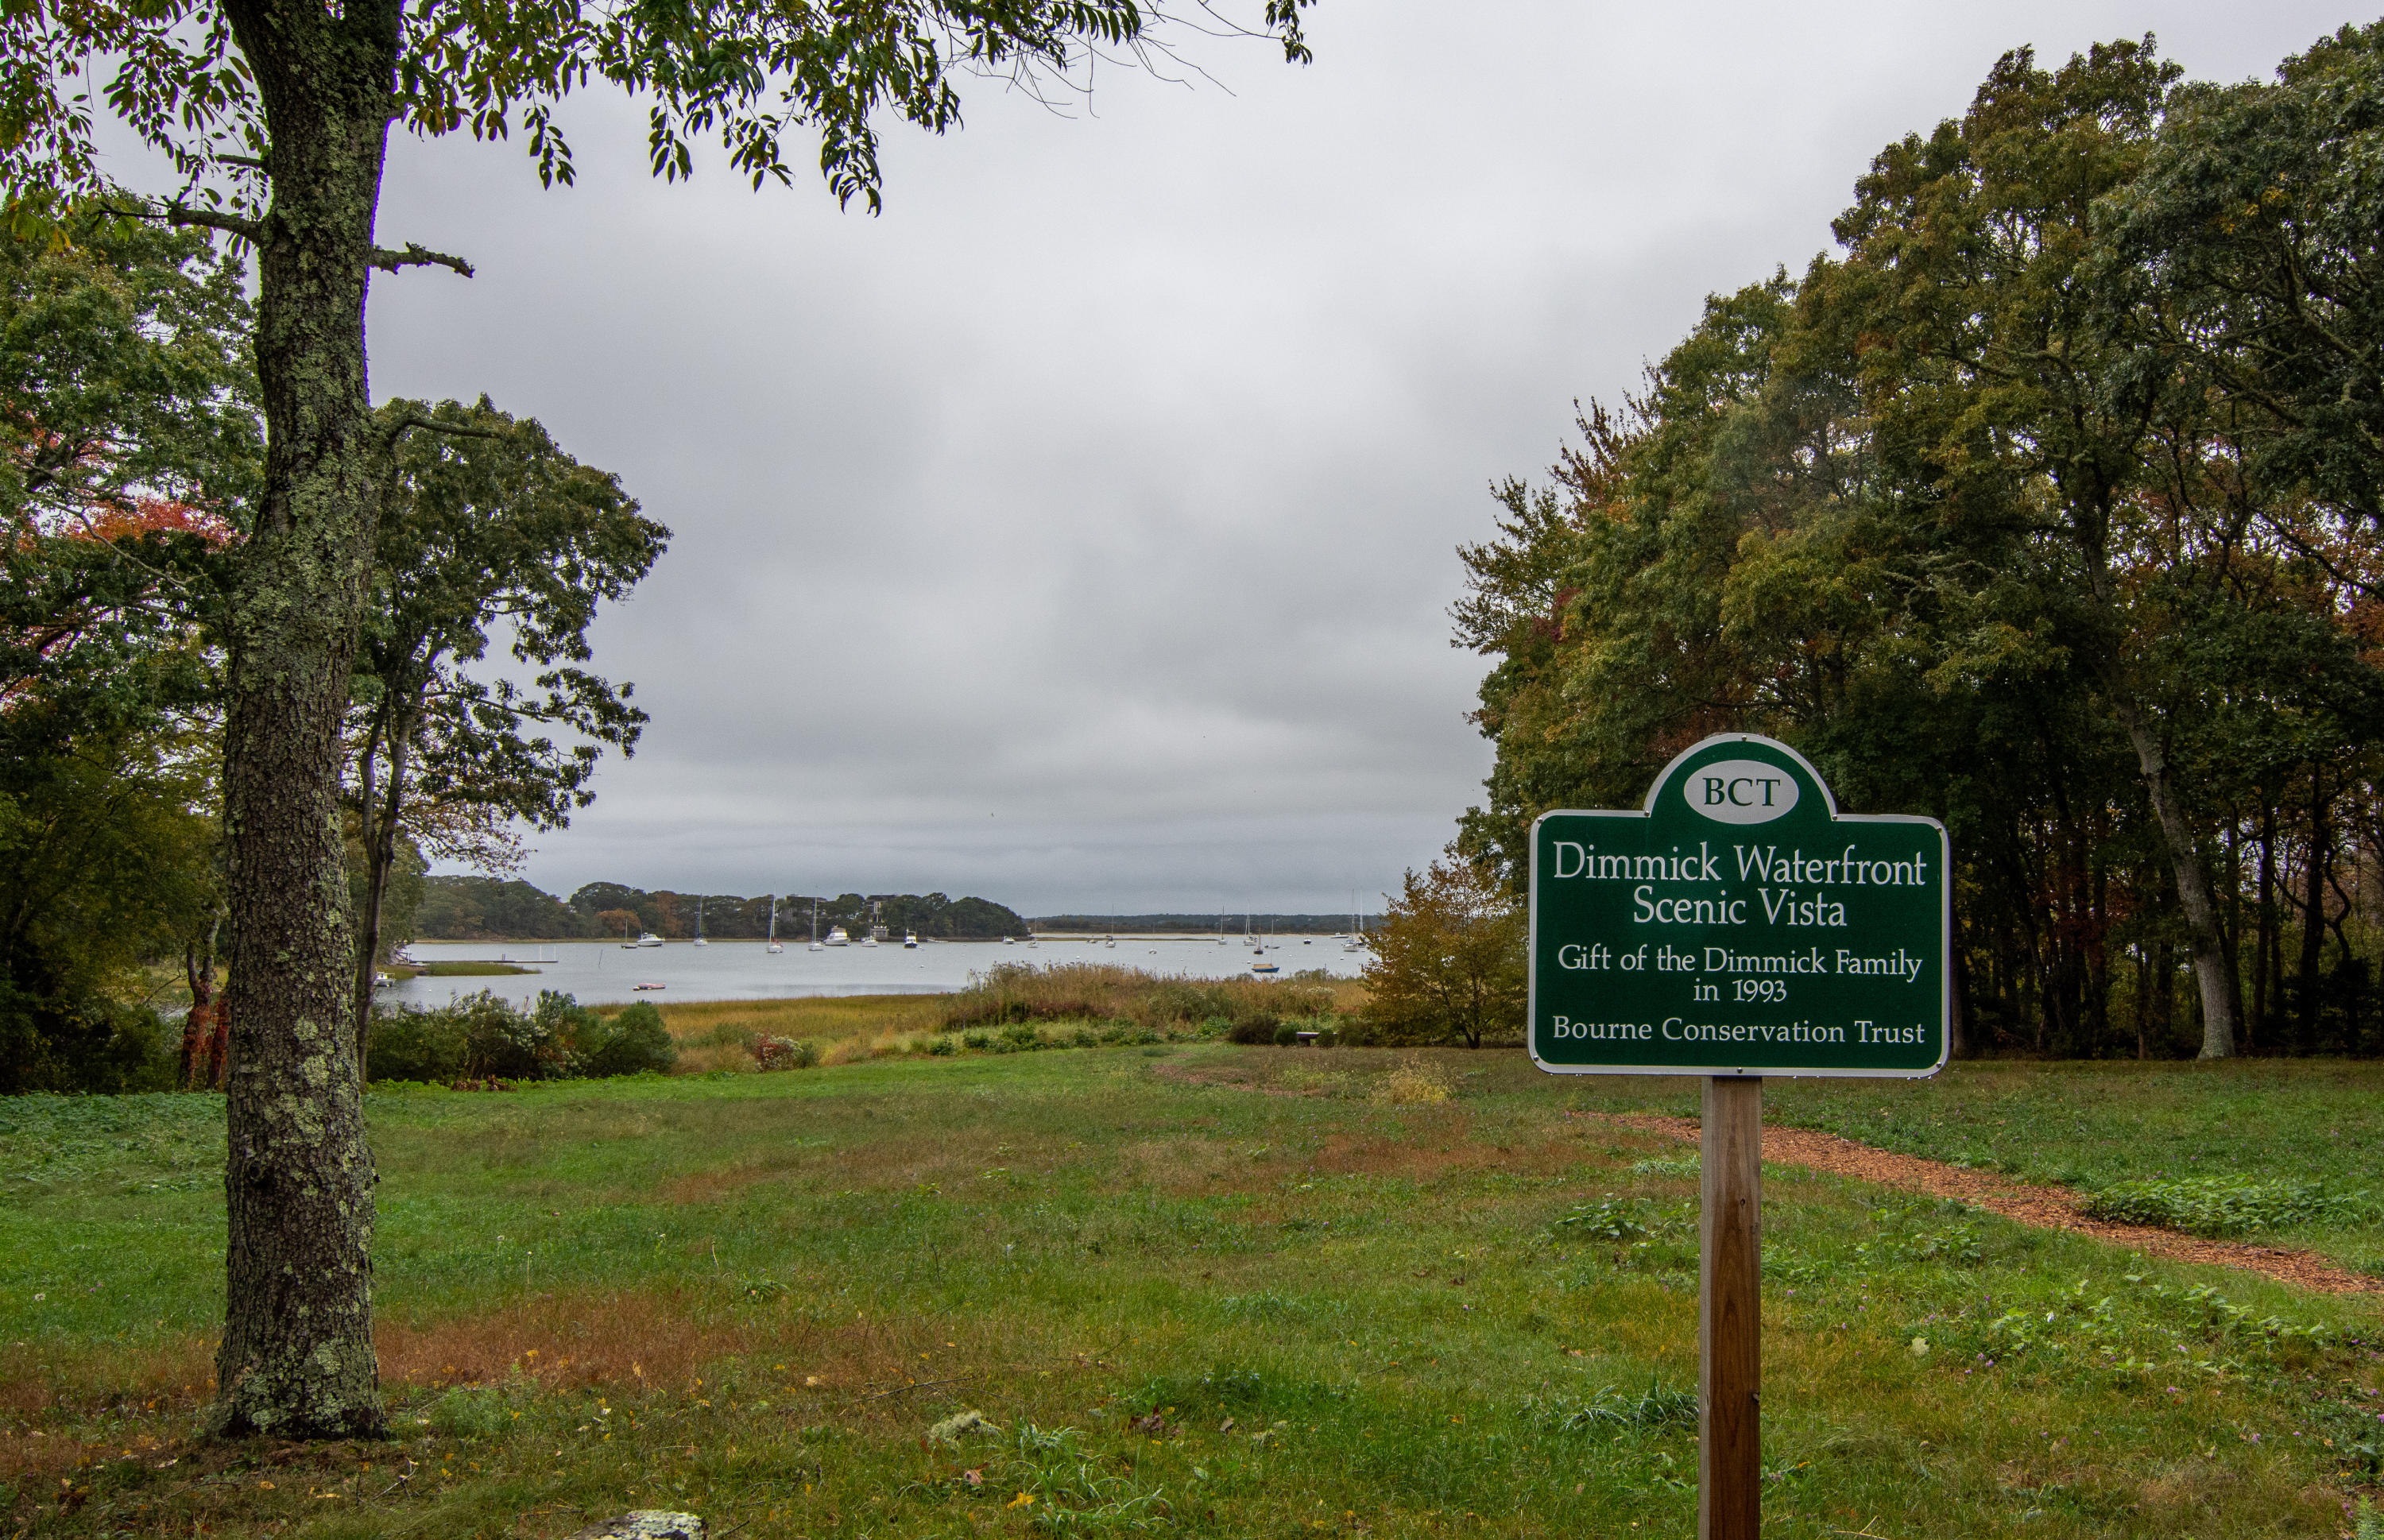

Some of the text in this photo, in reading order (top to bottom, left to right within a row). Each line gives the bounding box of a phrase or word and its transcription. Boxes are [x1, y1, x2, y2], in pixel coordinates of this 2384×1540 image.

[1703, 777, 1780, 807] BCT
[1553, 842, 1926, 885] Dimmick Waterfront
[1634, 885, 1847, 927] Scenic Vista
[1558, 943, 1922, 983] Gift of the Dimmick Family
[1693, 978, 1787, 1003] in 1993
[1553, 1016, 1925, 1043] Bourne Conservation Trust
